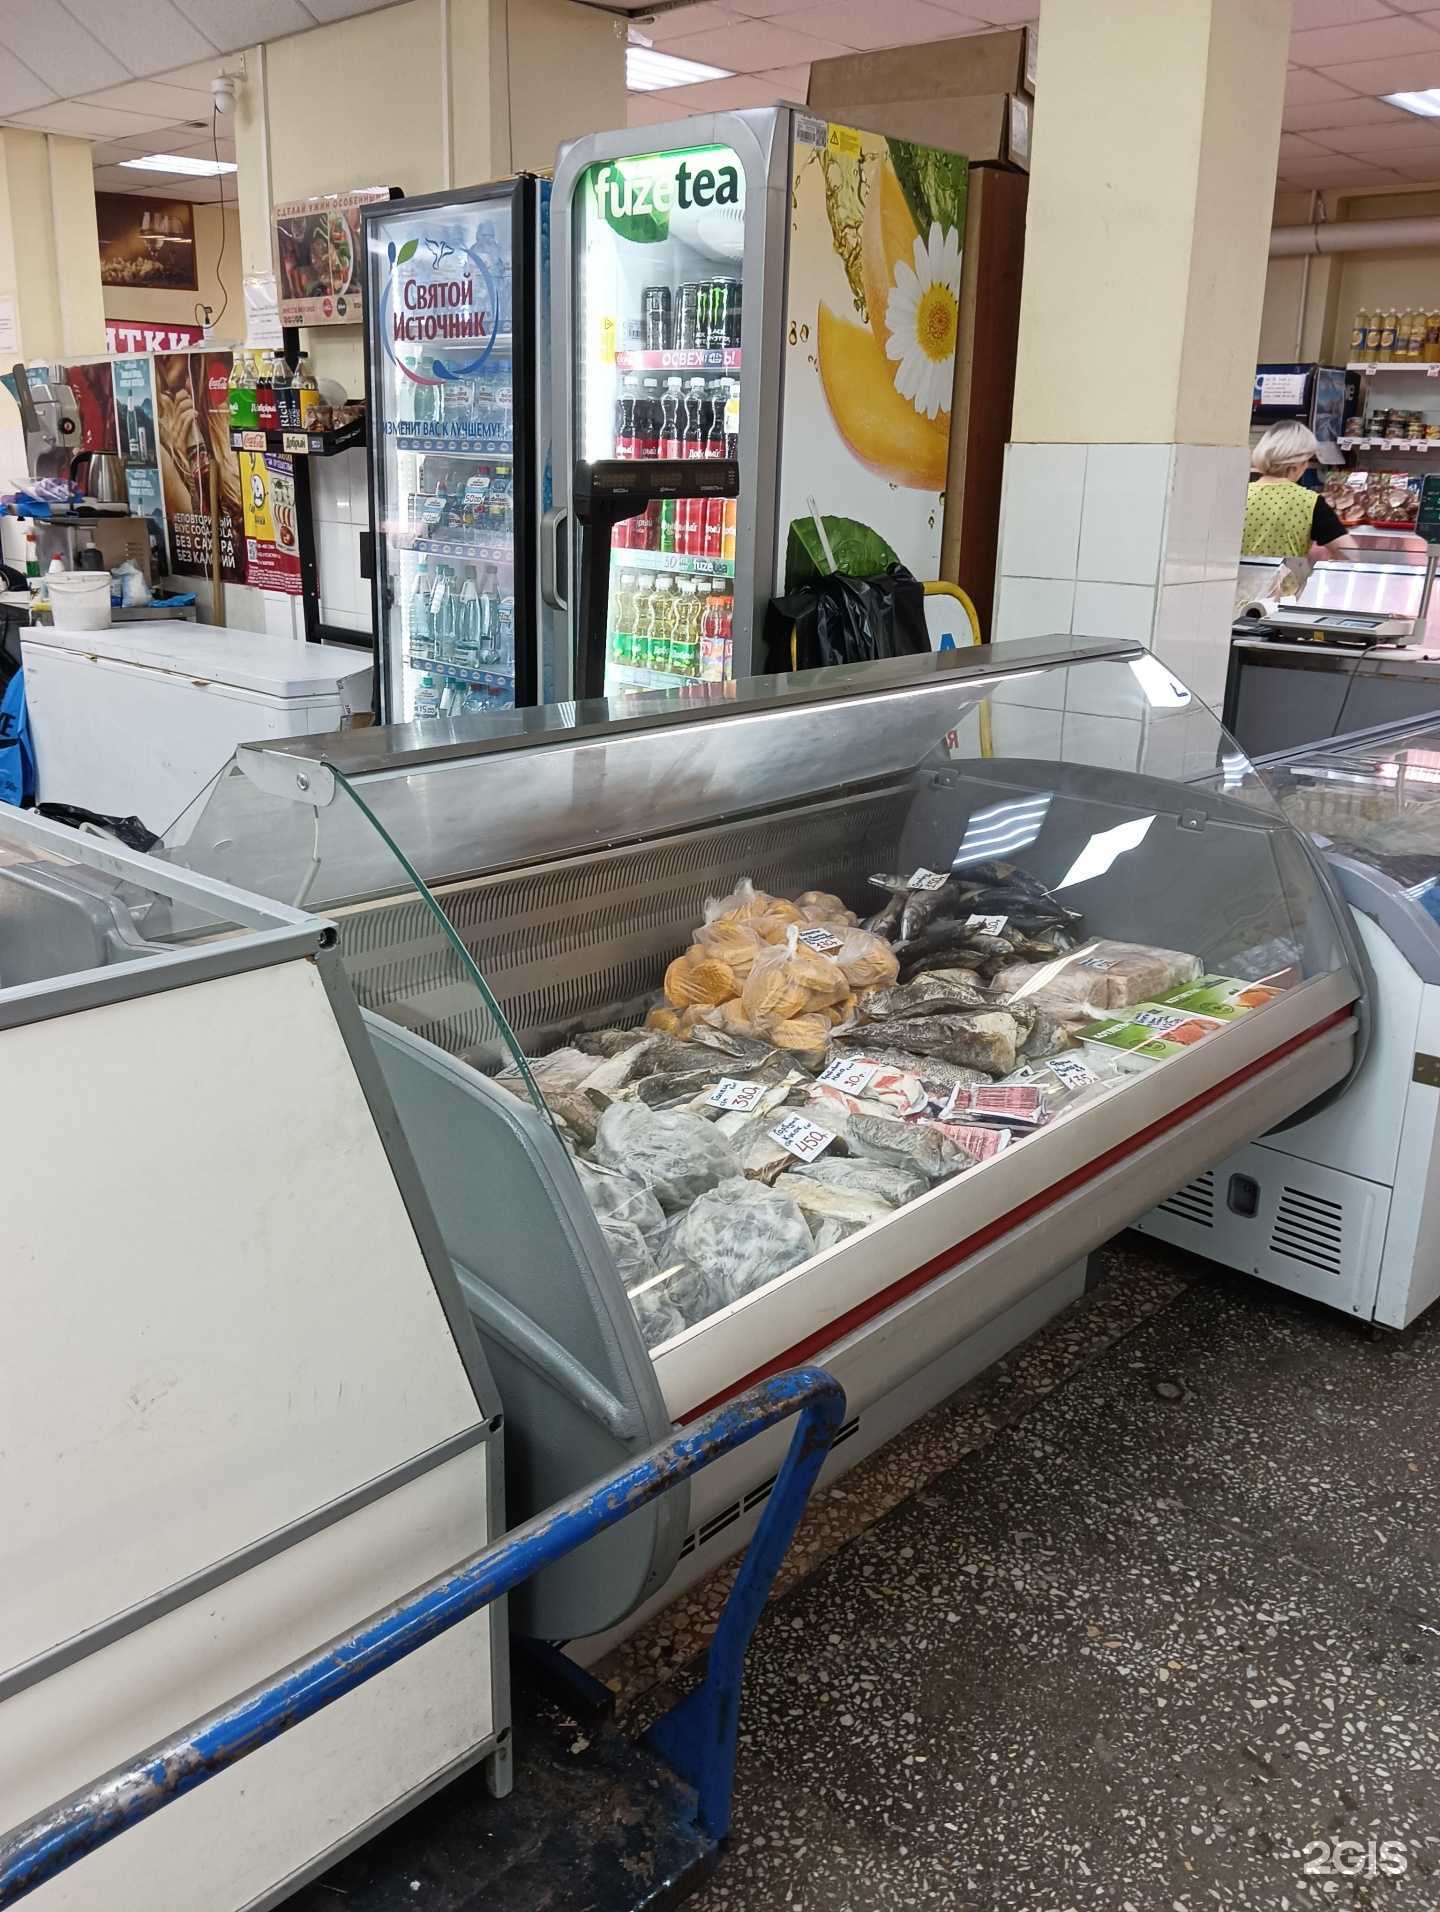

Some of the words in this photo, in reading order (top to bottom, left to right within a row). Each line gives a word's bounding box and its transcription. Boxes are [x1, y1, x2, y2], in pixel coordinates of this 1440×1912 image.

[662, 351, 736, 366] ОСВЕЖЬ!
[424, 422, 442, 437] ВАС
[174, 512, 232, 528] НЕПОВТОРИЫЙ
[176, 535, 191, 549] БЕЗ
[194, 537, 234, 554] САХРА
[176, 549, 192, 563] БЕЗ
